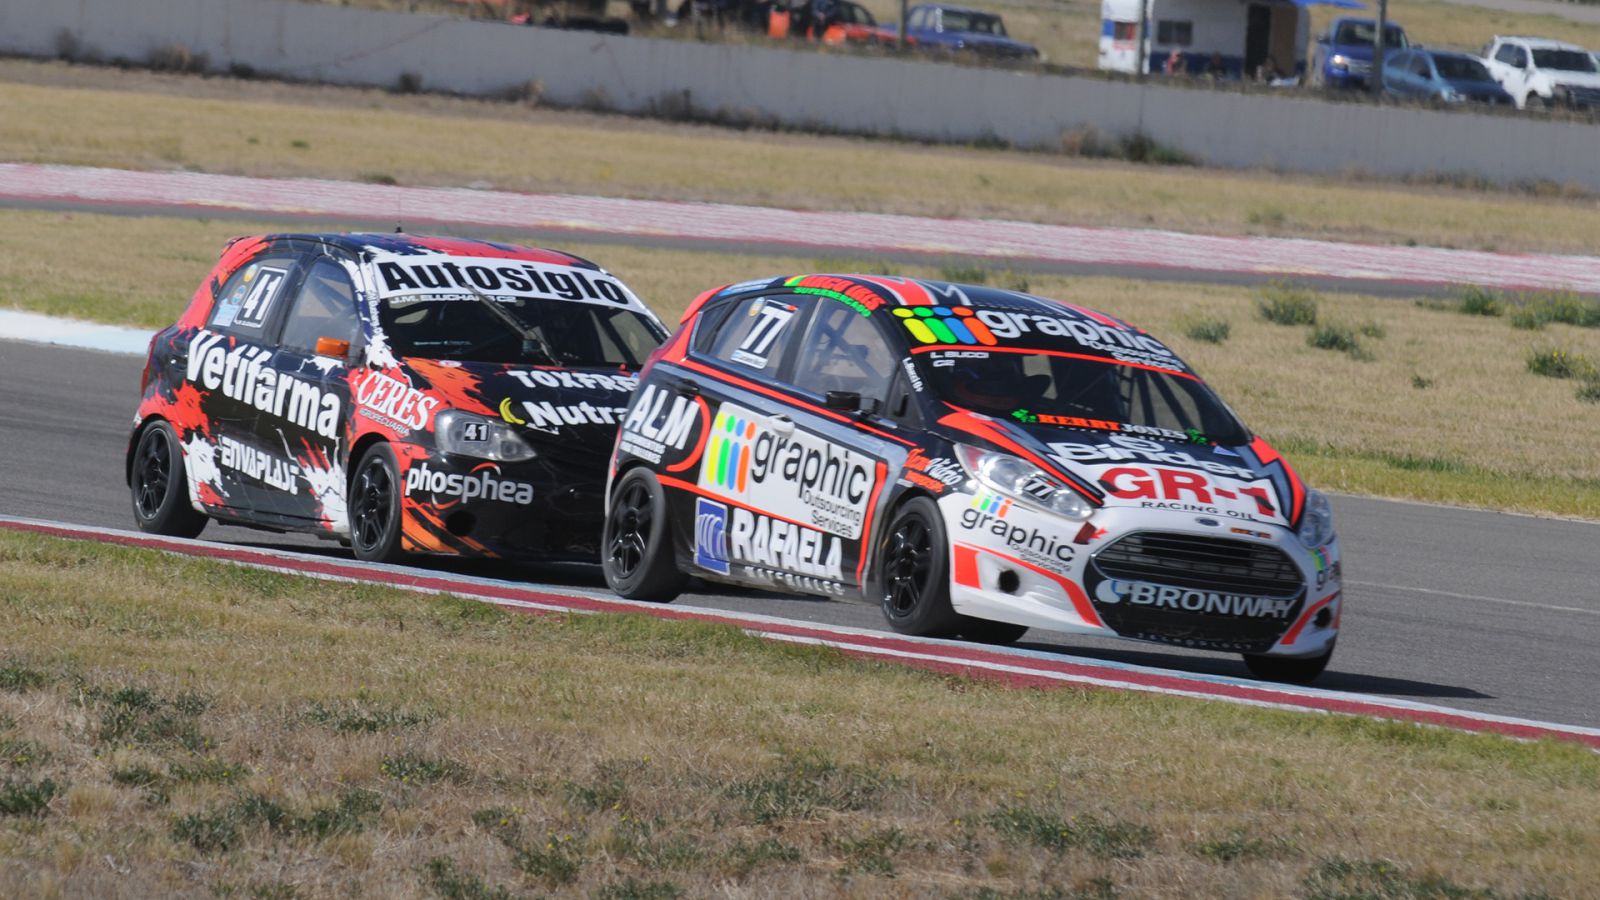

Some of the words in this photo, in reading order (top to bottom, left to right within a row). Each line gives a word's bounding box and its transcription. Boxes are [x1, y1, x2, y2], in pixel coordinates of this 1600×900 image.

[244, 274, 282, 320] 41
[376, 261, 629, 305] Autosiglo
[740, 307, 793, 354] 77
[975, 309, 1172, 357] graphic
[187, 330, 341, 440] Vetifarma
[357, 371, 439, 430] CERES
[464, 424, 488, 441] 41
[624, 384, 700, 450] ALM
[405, 462, 534, 504] phosphea
[752, 430, 868, 505] graphic
[1046, 442, 1254, 480] Binder
[803, 490, 862, 527] Outsourcing
[1100, 467, 1275, 518] GR-1
[1141, 501, 1219, 515] RACING
[1227, 510, 1257, 522] OIL
[732, 508, 844, 581] RAFAELA
[812, 510, 853, 537] Services
[960, 507, 1074, 563] graphic
[1130, 582, 1295, 619] BRONWAY
